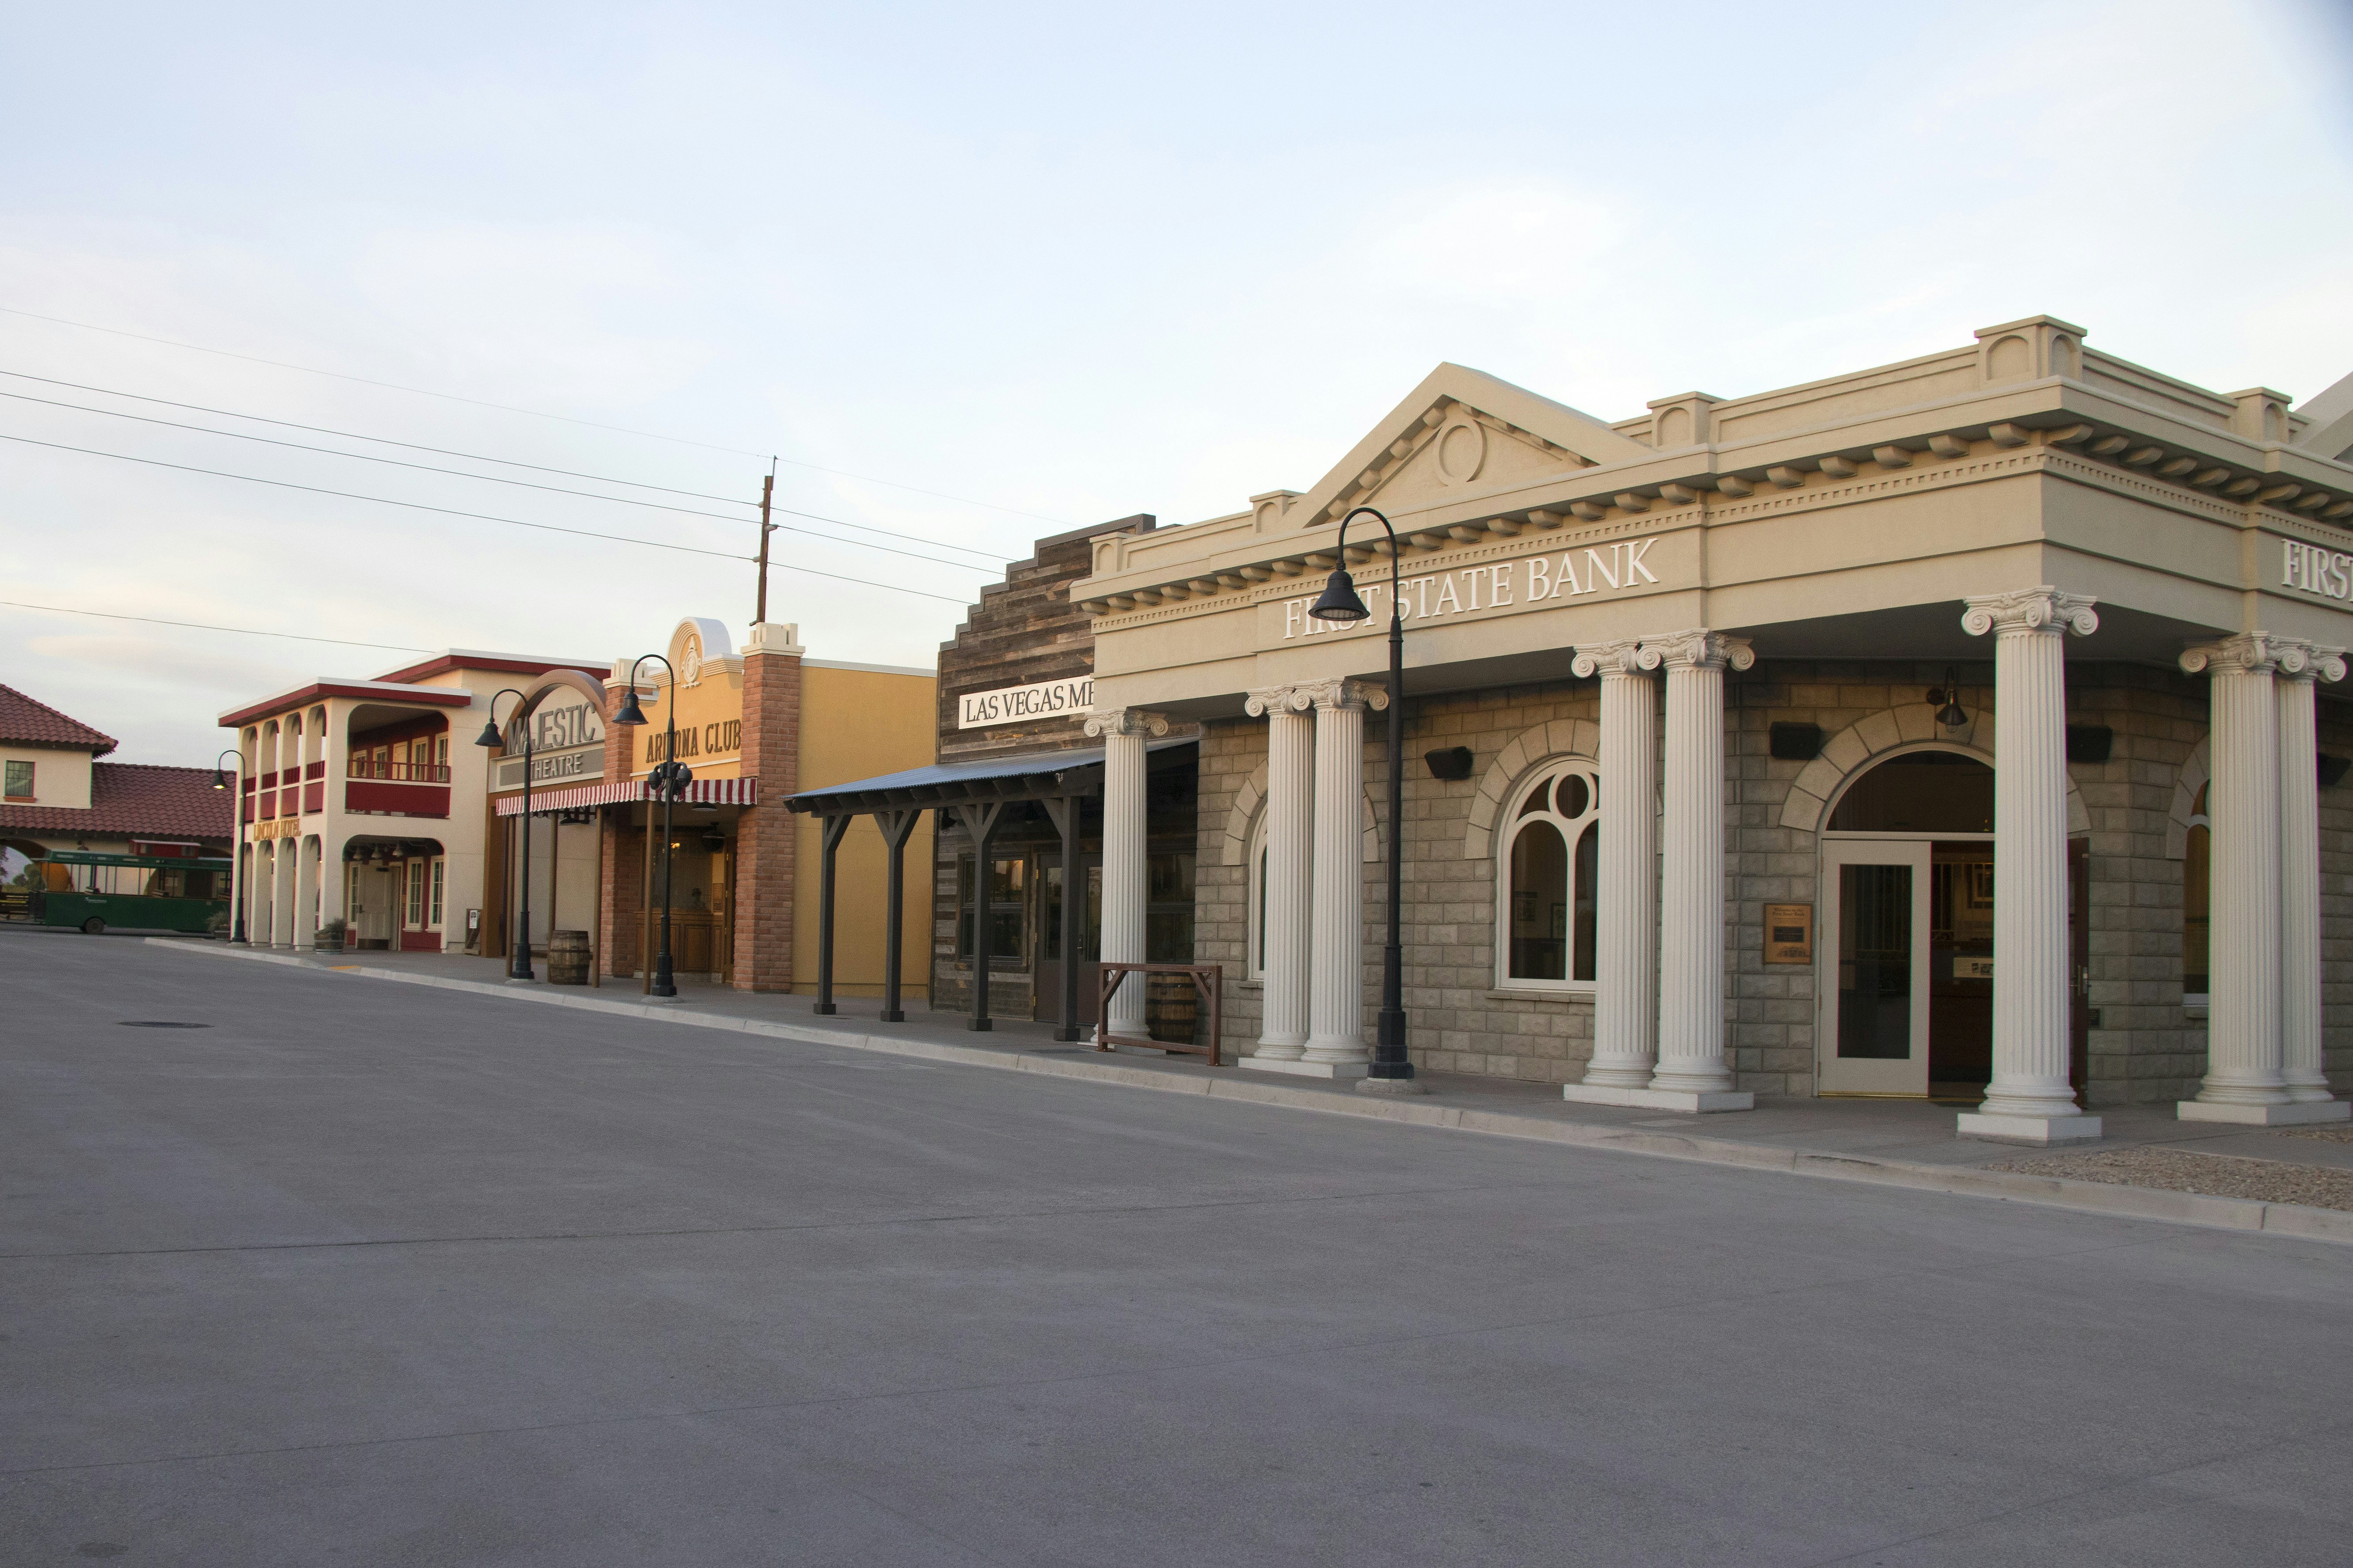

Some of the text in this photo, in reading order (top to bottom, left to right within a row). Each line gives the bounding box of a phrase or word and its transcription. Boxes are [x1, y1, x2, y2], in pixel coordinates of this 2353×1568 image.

[1283, 538, 1660, 639] FIT STATE BANK
[965, 695, 998, 722] LAS
[1002, 685, 1064, 717] VEGAS
[507, 701, 596, 755] MAJESTIC
[645, 719, 742, 763] ARIONA CLUB
[530, 754, 583, 779] THEATRE
[280, 818, 301, 838] HOTEL
